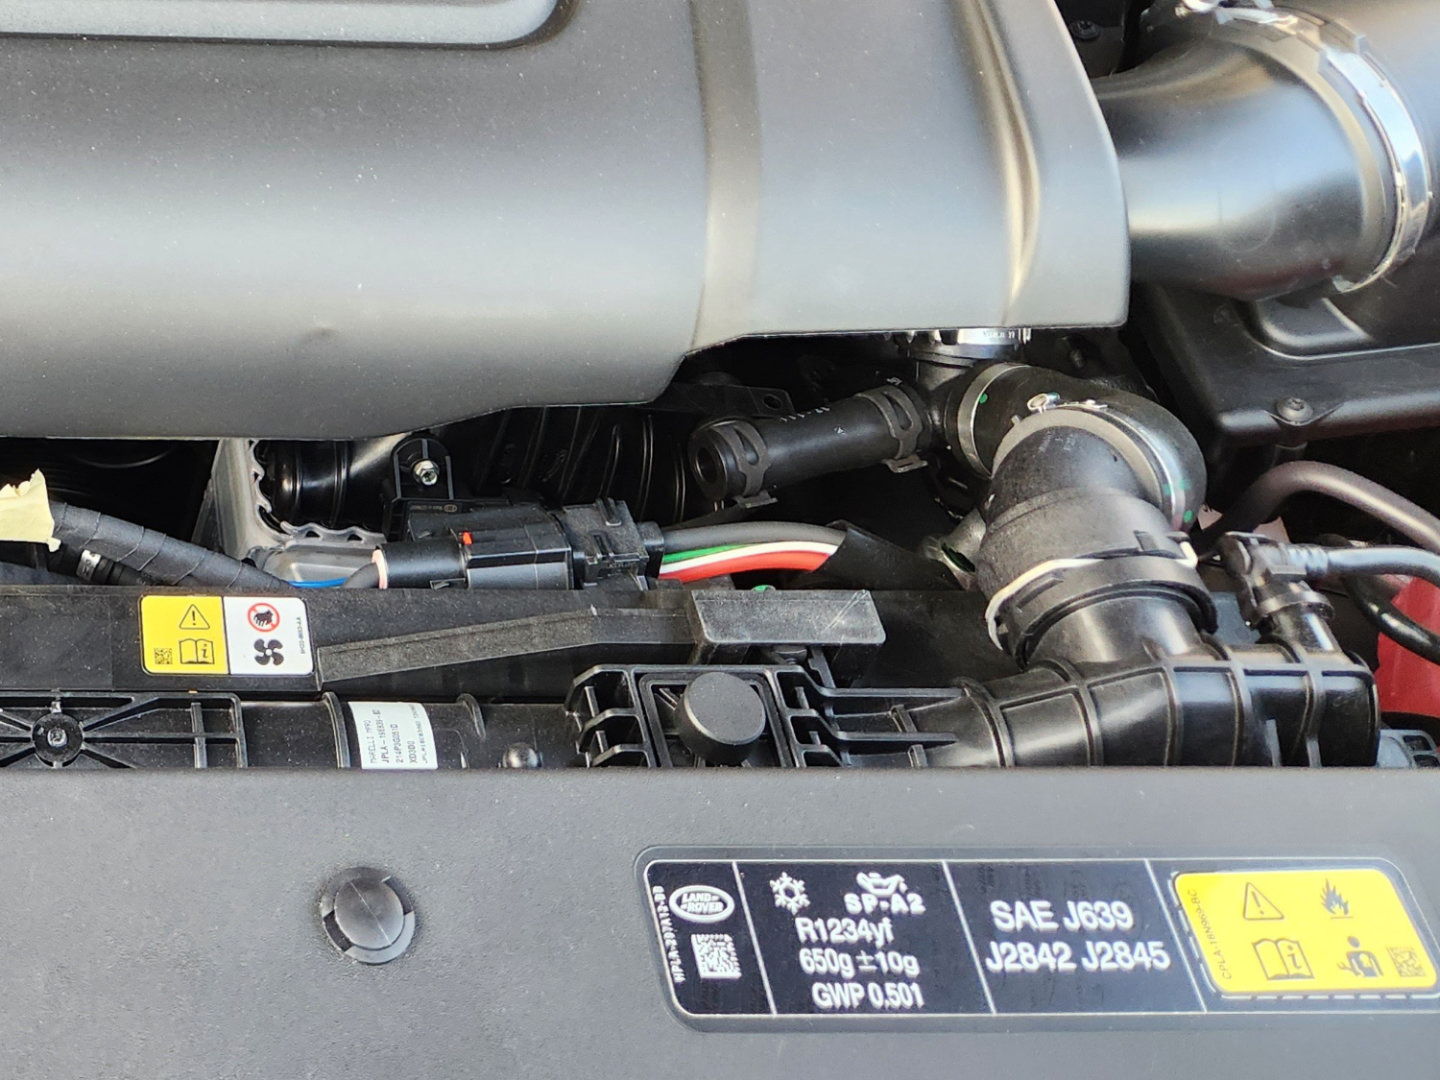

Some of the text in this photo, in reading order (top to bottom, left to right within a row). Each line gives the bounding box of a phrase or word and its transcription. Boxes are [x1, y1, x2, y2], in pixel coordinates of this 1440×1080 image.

[681, 892, 713, 903] LAND
[686, 901, 724, 914] ROVER
[843, 893, 927, 915] SP-A2
[989, 899, 1135, 932] SAE J639
[794, 916, 895, 949] R1234yf
[798, 947, 856, 980] 650g
[985, 940, 1172, 973] J2842 J2845
[811, 982, 925, 1010] GWP 0.501
